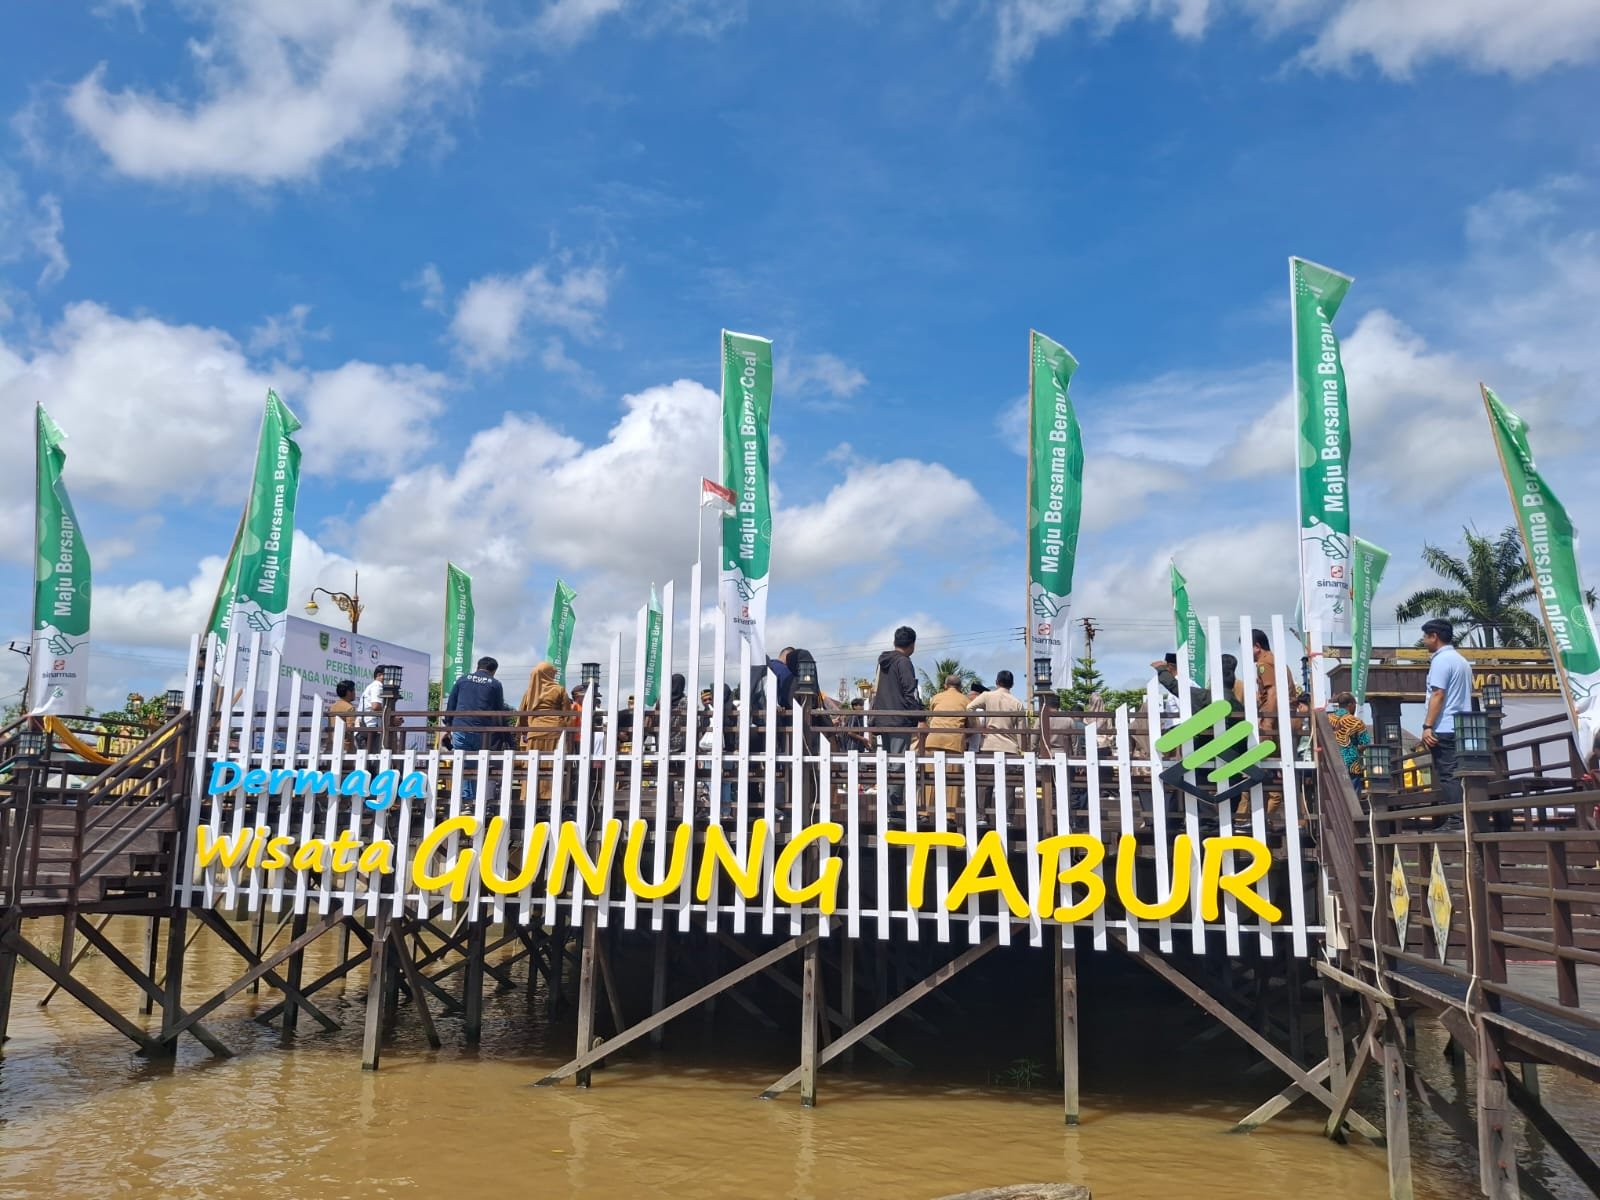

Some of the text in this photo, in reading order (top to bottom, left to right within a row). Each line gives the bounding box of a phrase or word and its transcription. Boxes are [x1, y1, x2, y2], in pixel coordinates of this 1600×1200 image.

[1318, 323, 1337, 375] Berau
[1049, 392, 1067, 442] Berau
[1321, 380, 1341, 460] Bersama
[739, 351, 758, 560] Maju Bersama Berau Coal
[1044, 447, 1066, 524] Bersama
[1322, 464, 1345, 512] Maju
[264, 485, 284, 551] Bersama
[54, 507, 76, 616] Maju Bersam
[257, 556, 279, 594] Maju
[1040, 528, 1063, 573] Maju
[1529, 512, 1557, 599] Bersama
[457, 594, 466, 621] Berau
[1545, 604, 1573, 652] Maju
[455, 622, 466, 664] Bersama
[208, 761, 428, 811] Dermaga
[197, 815, 1282, 923] Wisata GUNUNG TABUR
